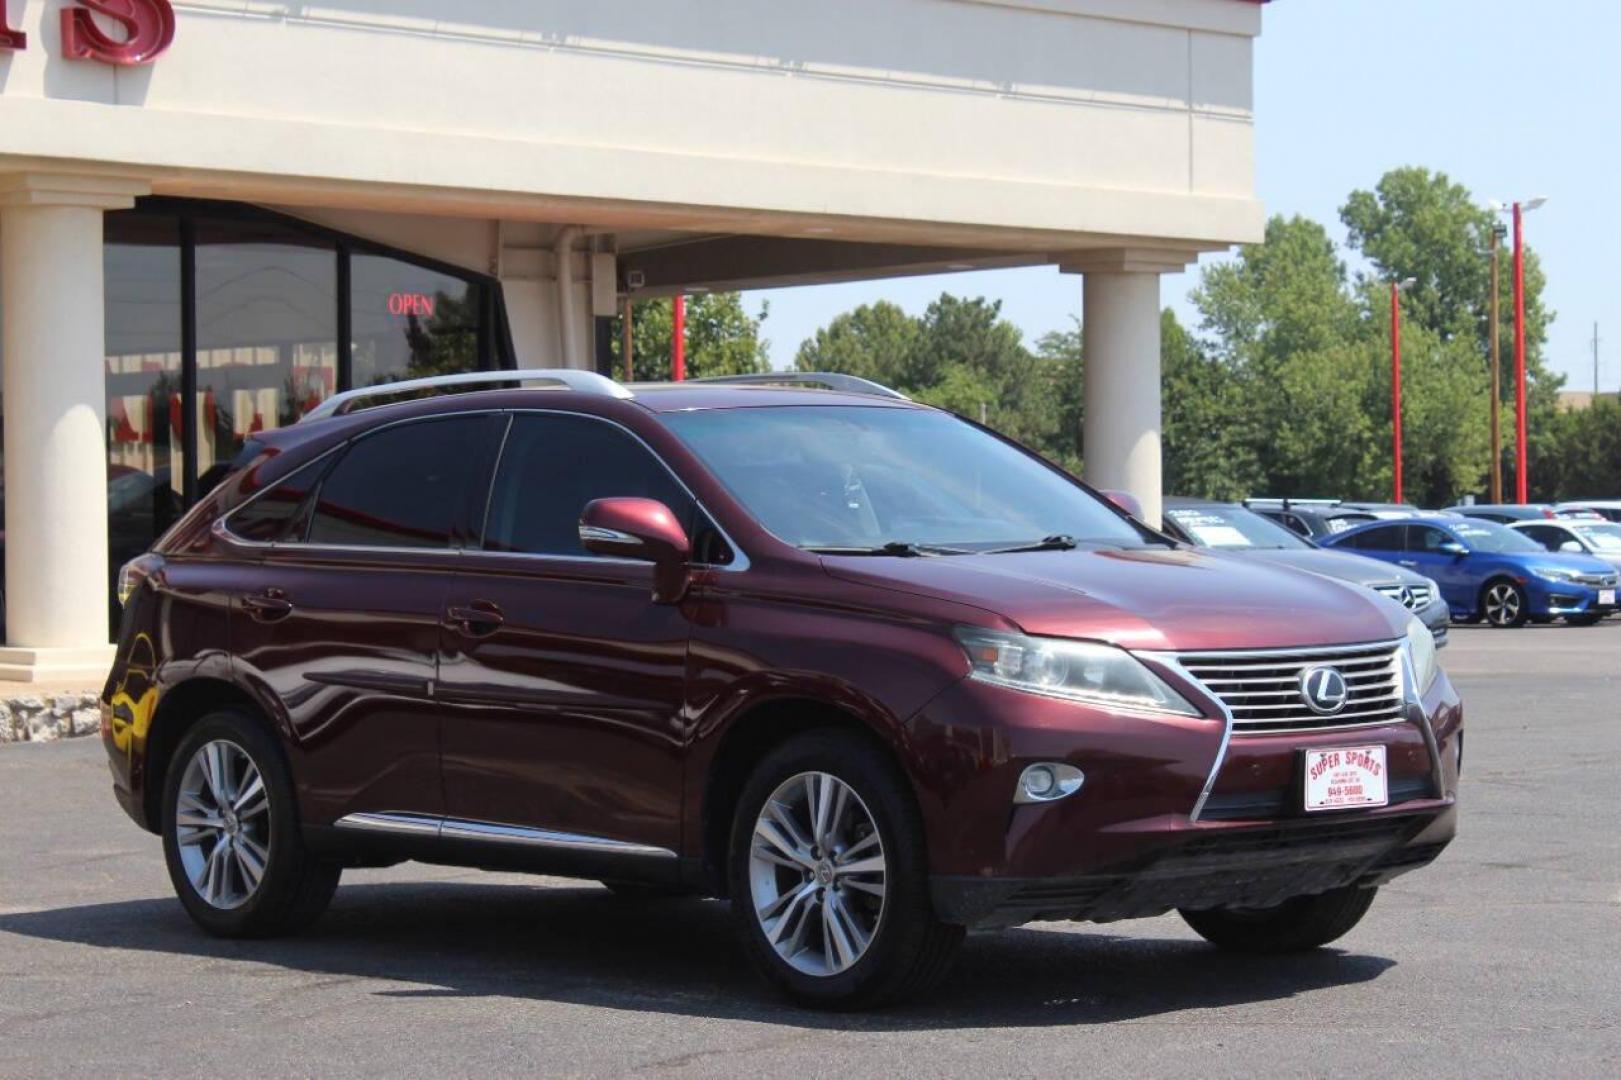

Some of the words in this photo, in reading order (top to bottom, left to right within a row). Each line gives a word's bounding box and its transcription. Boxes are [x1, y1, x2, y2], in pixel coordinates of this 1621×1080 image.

[387, 292, 434, 318] OPEN
[1310, 752, 1341, 781] SUPER
[1345, 751, 1382, 777] SPORTS
